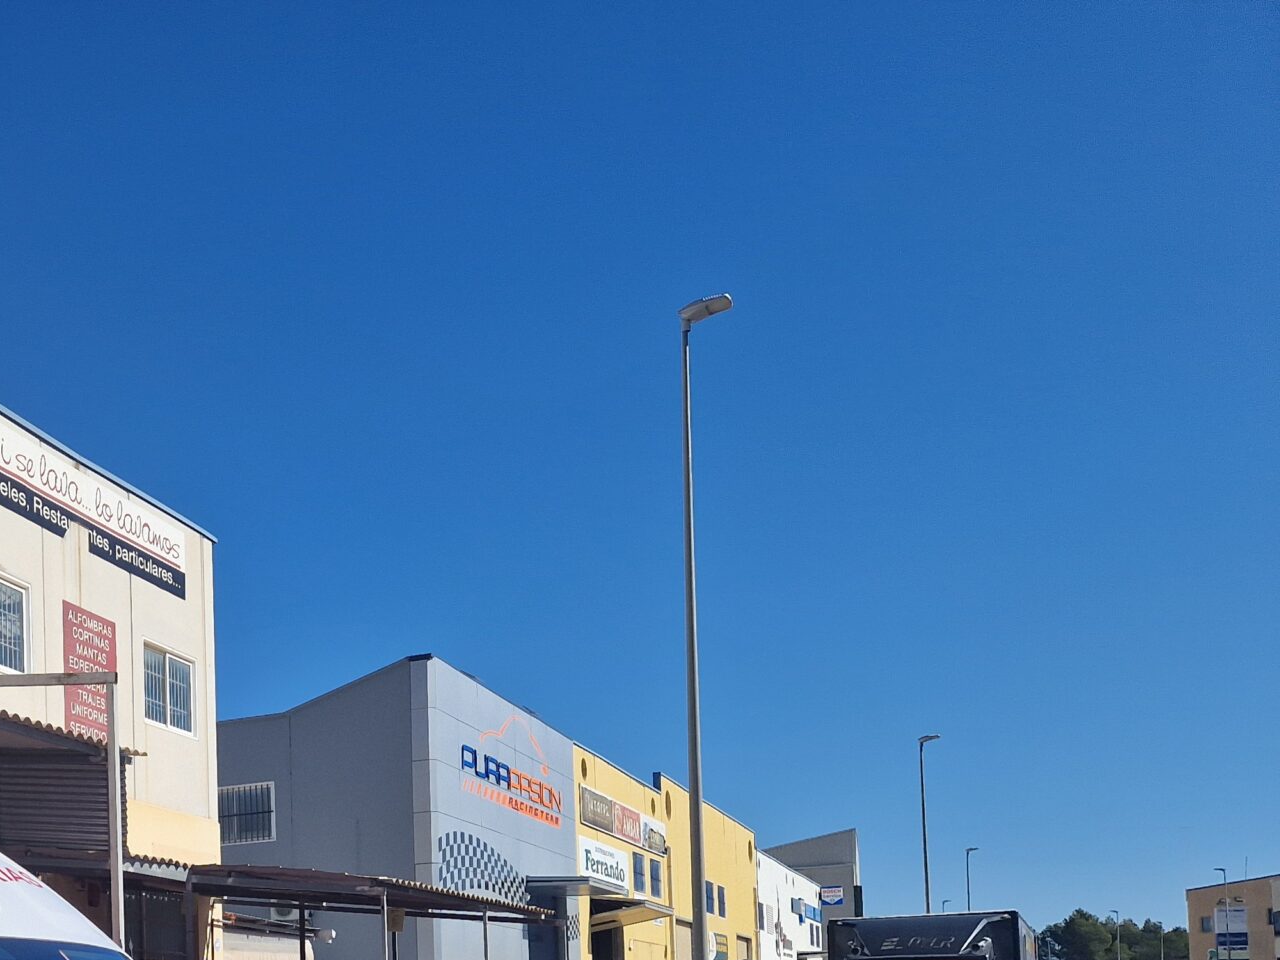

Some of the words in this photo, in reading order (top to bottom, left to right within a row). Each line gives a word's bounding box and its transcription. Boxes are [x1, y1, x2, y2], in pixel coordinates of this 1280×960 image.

[15, 453, 35, 478] se
[95, 487, 113, 521] lo
[117, 500, 180, 559] lavamos
[116, 544, 181, 588] particulares...
[68, 609, 112, 638] ALFOMBRAS
[72, 627, 109, 651] CORTINAS
[76, 643, 107, 665] MANTAS
[71, 702, 107, 725] UNIFORME
[585, 848, 625, 883] Ferrando
